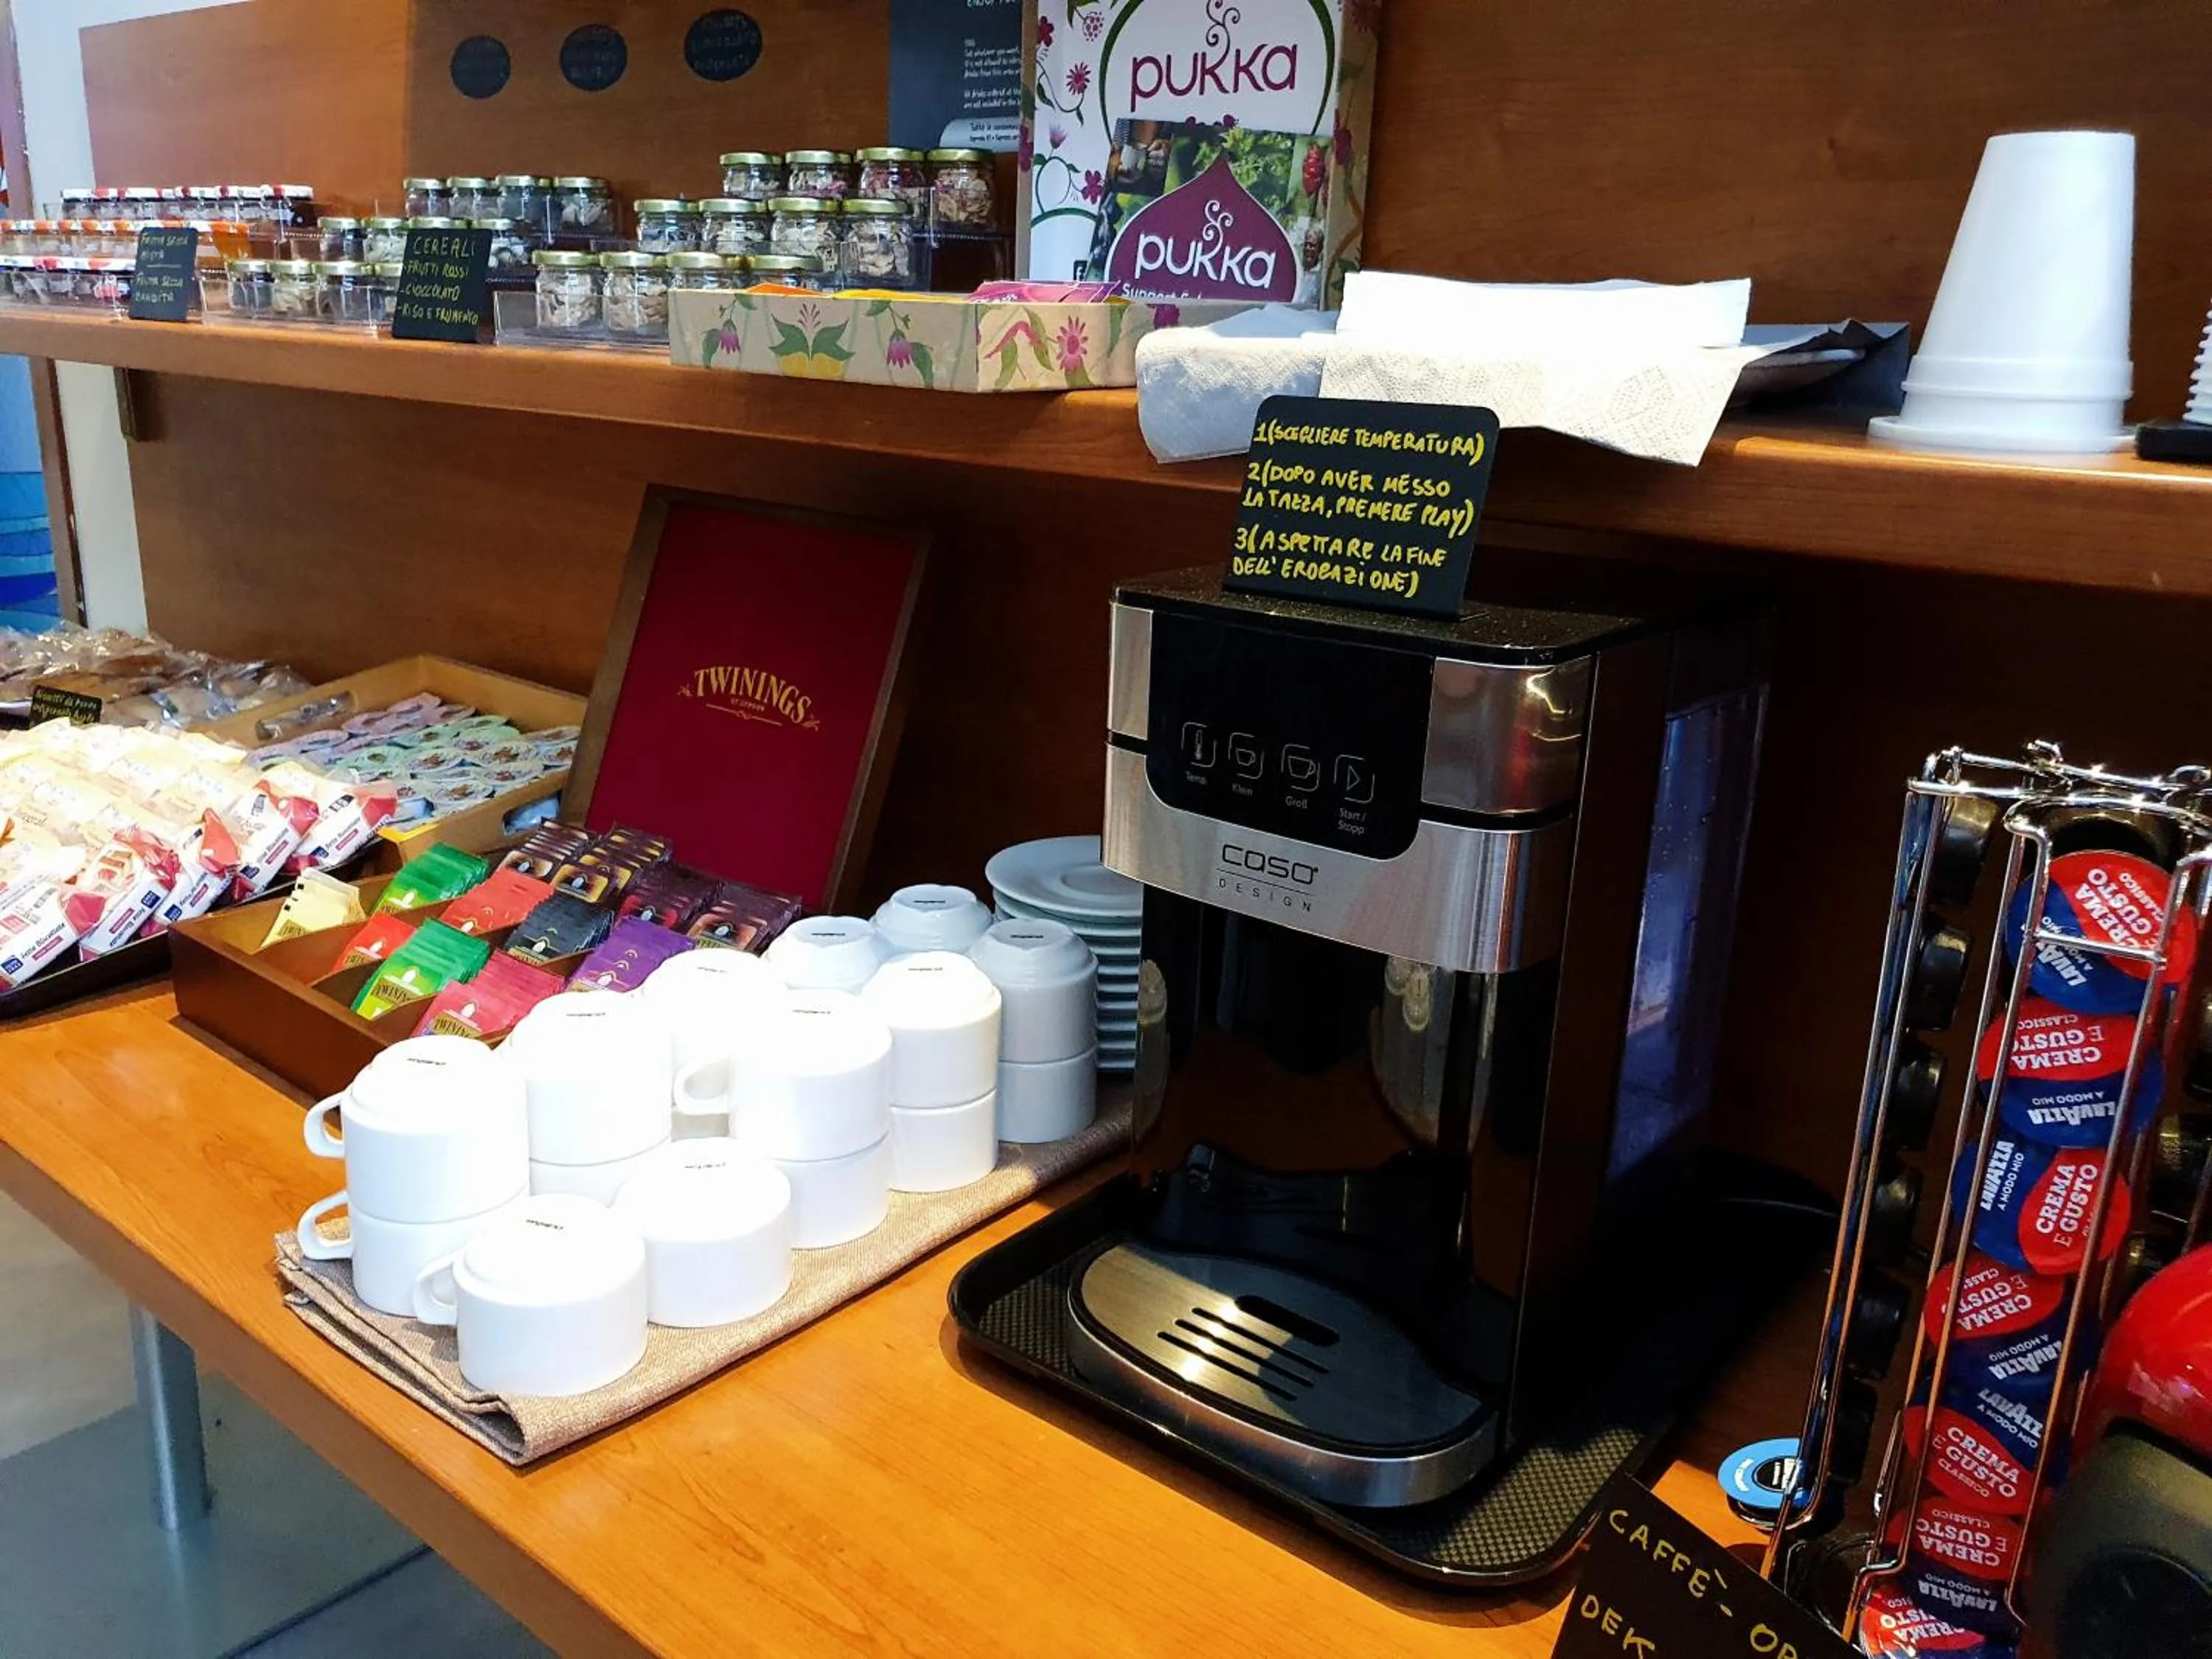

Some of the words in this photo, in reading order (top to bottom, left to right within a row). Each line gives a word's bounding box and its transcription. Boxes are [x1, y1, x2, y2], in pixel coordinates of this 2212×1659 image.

[1130, 44, 1299, 114] pukka
[412, 236, 476, 257] CEREALI
[1135, 231, 1277, 289] pukka
[426, 307, 434, 319] E
[1321, 469, 1374, 493] AVER
[1382, 473, 1452, 498] MESSO
[1242, 487, 1265, 507] LA
[1335, 495, 1418, 523] PREMERE
[1380, 543, 1402, 563] LA
[1405, 546, 1447, 568] FINE
[694, 665, 812, 724] TWININGS
[1217, 877, 1312, 912] DESIGN
[2088, 868, 2152, 935] GUSTO
[2011, 1046, 2101, 1070] CREMA
[2027, 1101, 2118, 1127] LAVAZZA
[2031, 1096, 2055, 1106] MIO
[2056, 1091, 2094, 1105] MODO
[1980, 1140, 2015, 1211] LAVAZZA
[2002, 1171, 2018, 1204] MODO
[2010, 1152, 2025, 1174] MIO
[2035, 1164, 2077, 1234] CREMA
[2059, 1164, 2098, 1233] GUSTO
[2053, 1232, 2073, 1248] E
[1942, 1281, 2012, 1315] GUST
[1956, 1293, 2033, 1335] CREMA
[1988, 1349, 2011, 1363] MIO
[2008, 1338, 2042, 1355] MODO
[1977, 1387, 2044, 1439] LAVAZZ
[1985, 1408, 2019, 1435] MODO
[1945, 1445, 2017, 1498] GUSTO
[1947, 1426, 2020, 1484] CREMA
[1938, 1457, 1990, 1498] CLASSICO
[1931, 1509, 1991, 1528] CLASSICO
[1919, 1534, 2001, 1567] CREMA
[1918, 1579, 1998, 1613] LAVAZZA
[1580, 1594, 1656, 1659] DEK
